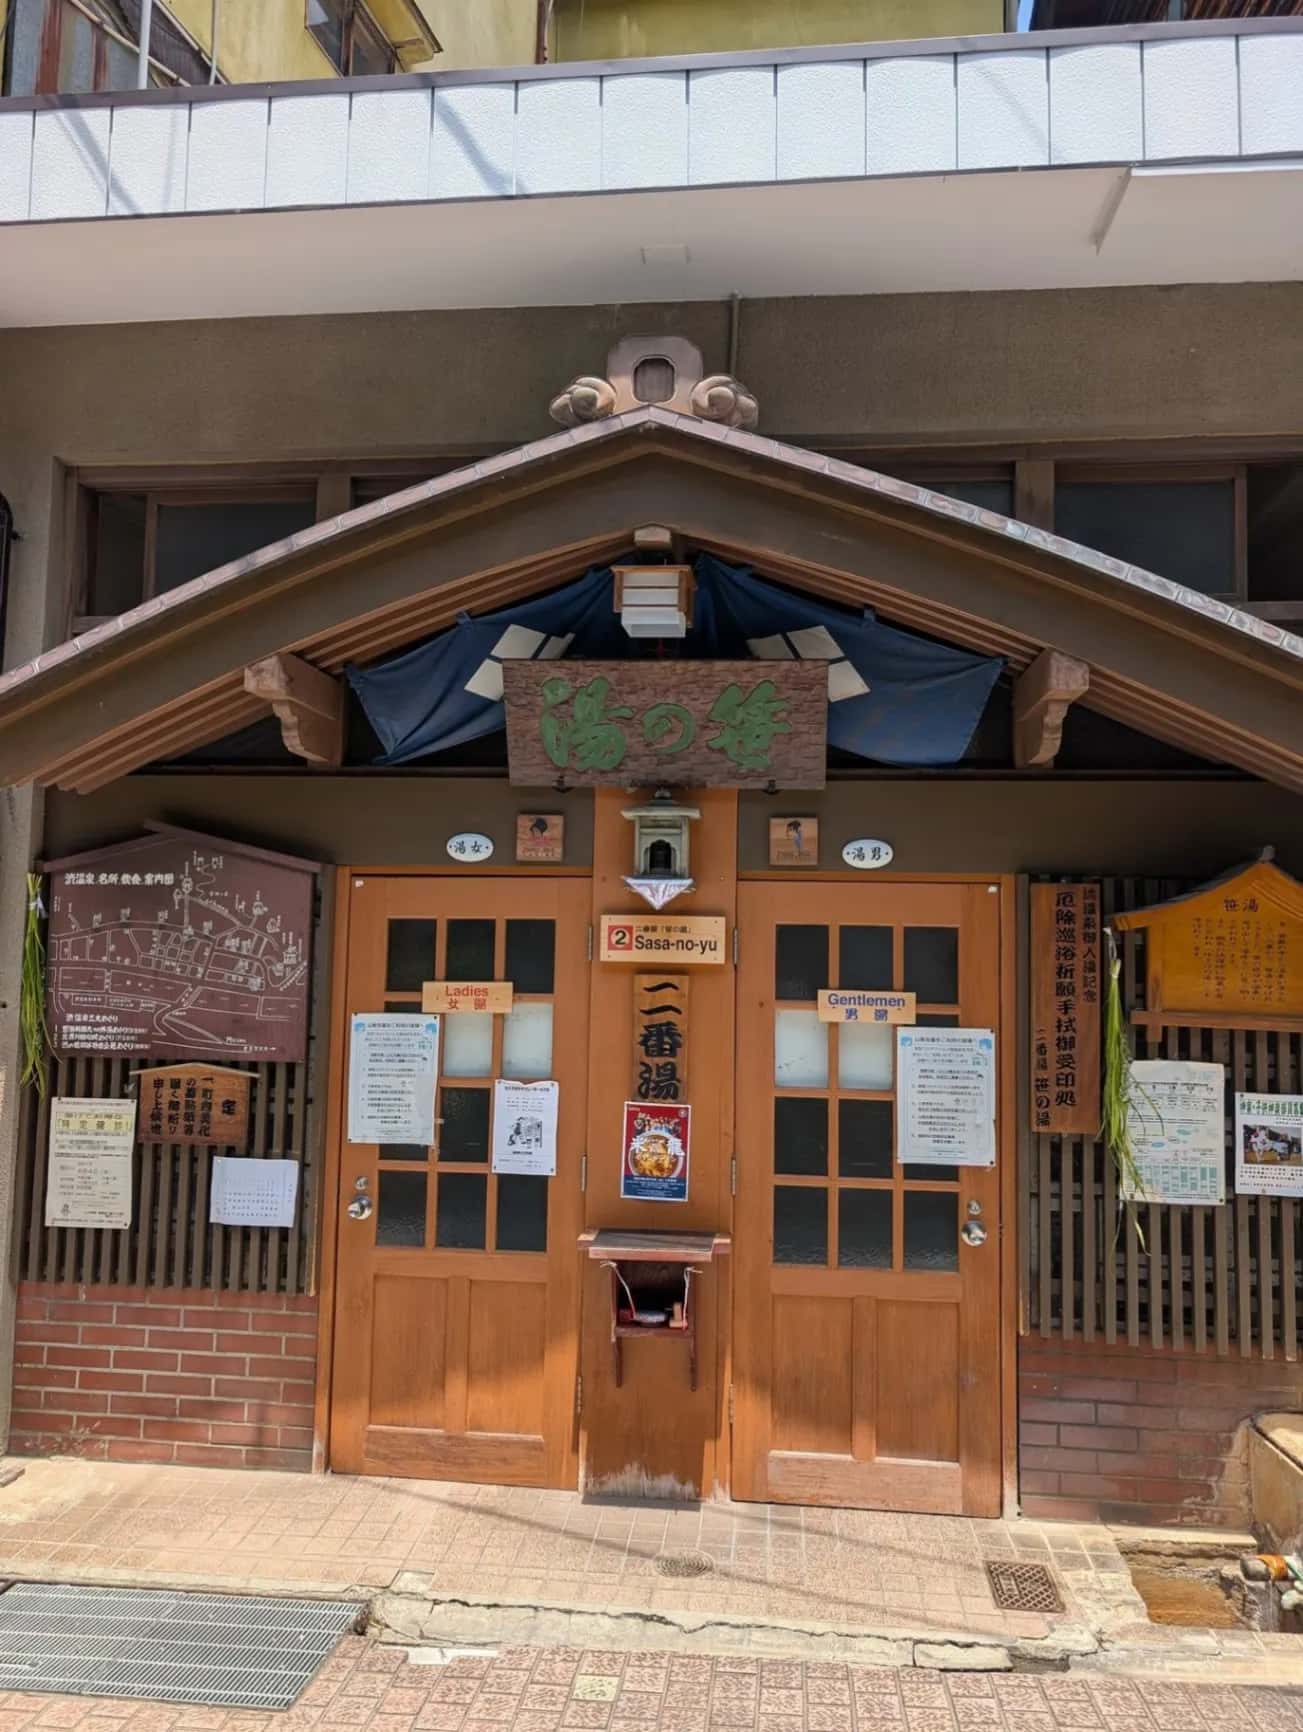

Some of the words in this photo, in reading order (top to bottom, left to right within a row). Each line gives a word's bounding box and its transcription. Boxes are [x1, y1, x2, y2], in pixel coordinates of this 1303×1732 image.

[615, 930, 627, 945] 2
[635, 935, 717, 954] Sasa-no-yu
[445, 984, 489, 997] Ladies
[828, 993, 905, 1008] Gentlemen
[638, 982, 682, 1100] 二番湯
